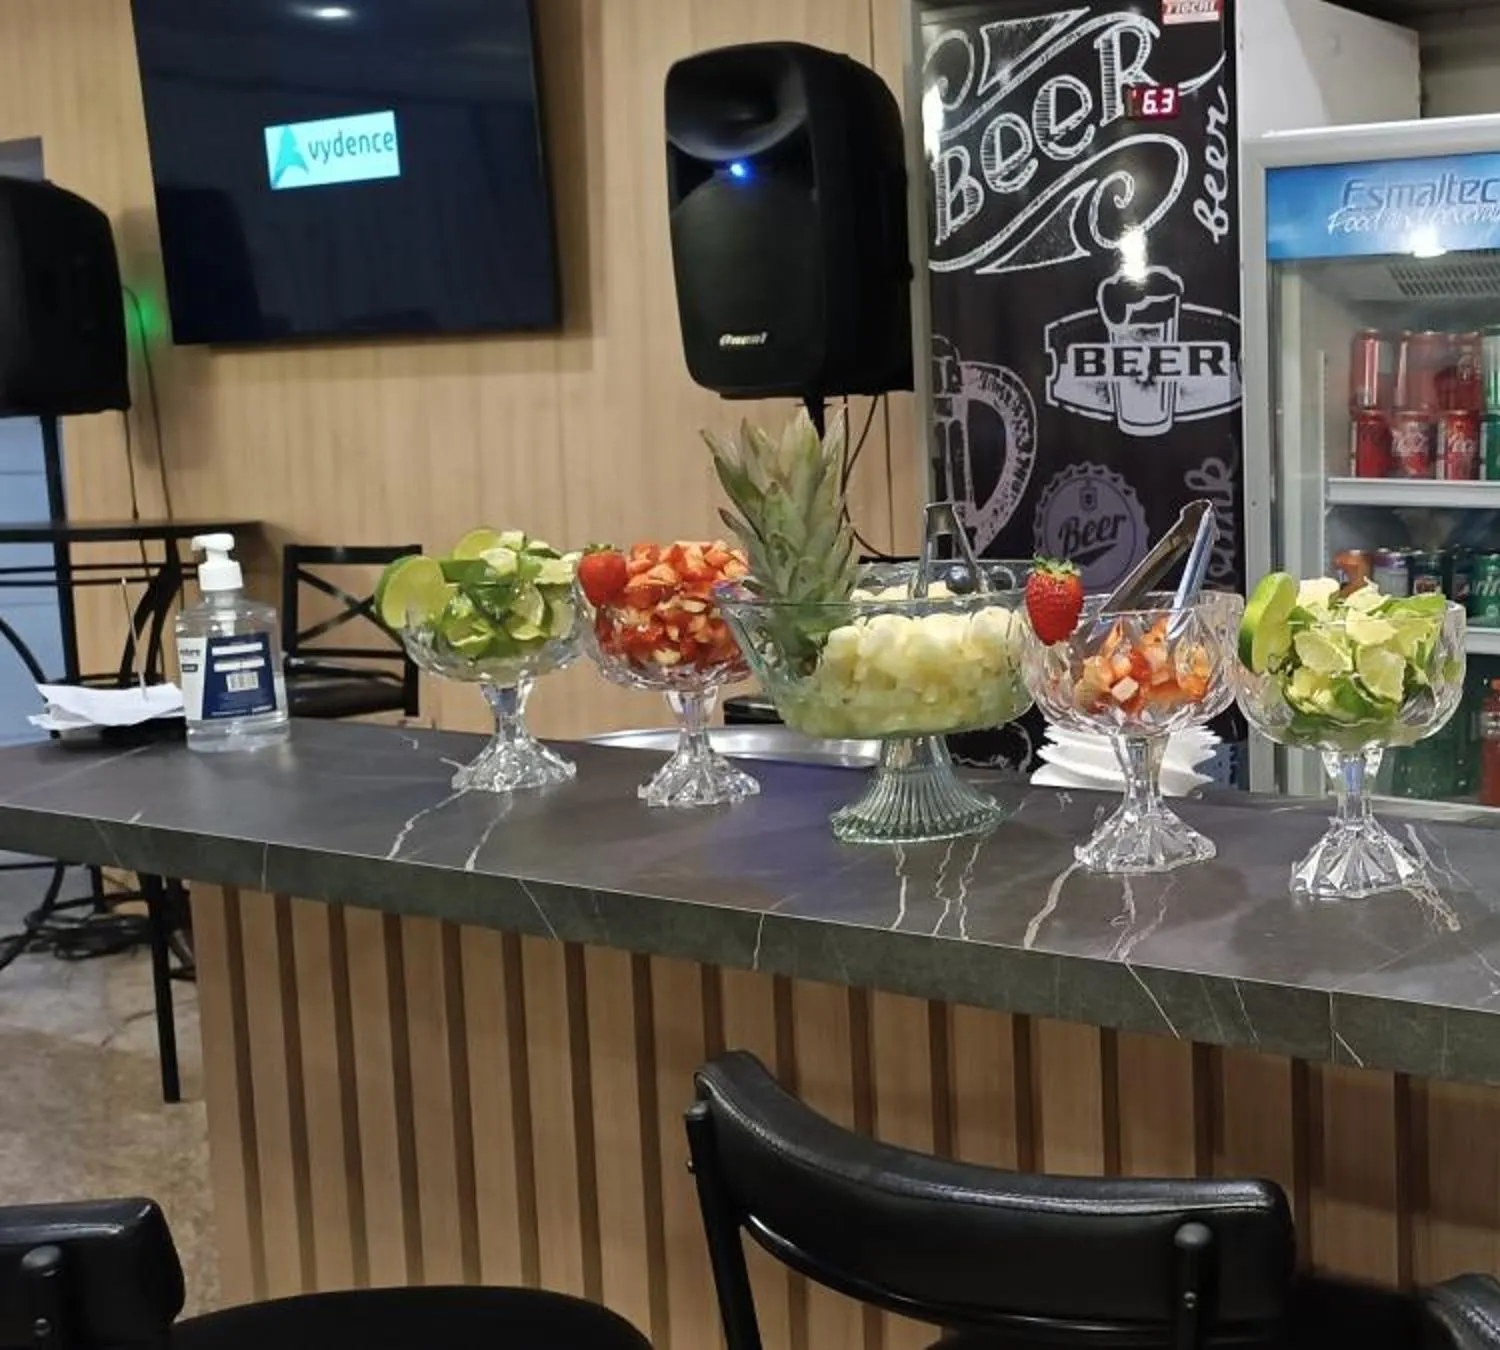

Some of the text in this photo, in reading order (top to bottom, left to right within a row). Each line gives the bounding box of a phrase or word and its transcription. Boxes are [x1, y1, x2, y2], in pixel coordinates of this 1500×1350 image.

[308, 128, 395, 165] vydence
[1074, 346, 1229, 378] BEER
[1057, 512, 1127, 555] Beer
